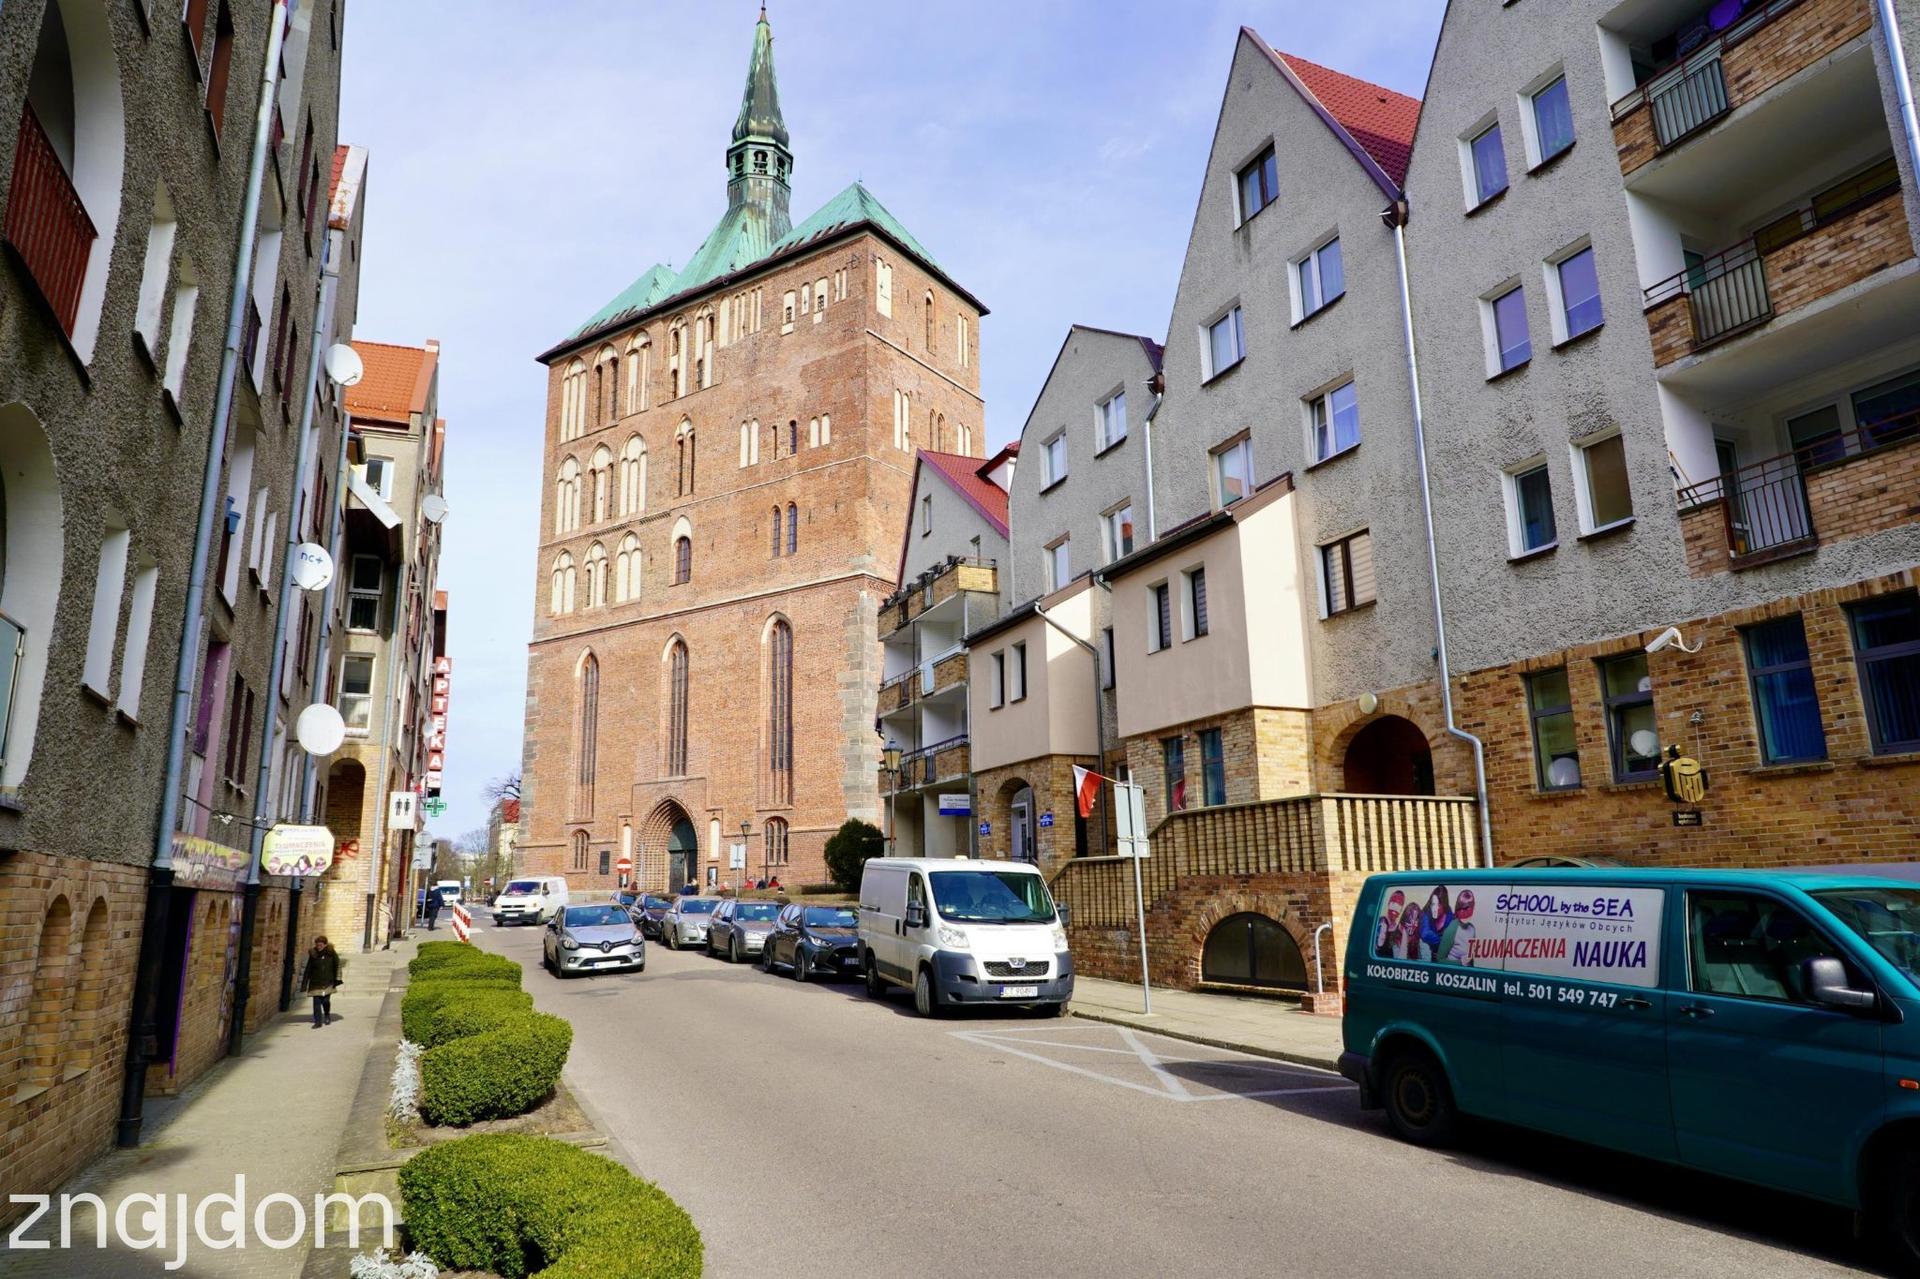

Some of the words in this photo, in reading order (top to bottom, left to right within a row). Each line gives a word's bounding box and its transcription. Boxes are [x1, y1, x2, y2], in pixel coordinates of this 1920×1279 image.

[300, 552, 323, 564] nc+
[429, 658, 450, 768] APTEKA
[1496, 894, 1558, 913] SCHOOL
[1560, 901, 1572, 914] by
[1573, 901, 1589, 913] the
[1592, 897, 1634, 918] SEA
[1540, 919, 1585, 930] Języków
[1589, 921, 1633, 934] Obcych
[1467, 937, 1566, 959] TŁUMACZENIA
[1572, 940, 1647, 968] NAUKA
[1366, 964, 1430, 985] KOŁOBRZEG
[1435, 972, 1497, 993] KOSZALIN
[1503, 981, 1524, 997] tel.
[1528, 984, 1552, 1000] 501
[1557, 987, 1585, 1004] 549
[1589, 990, 1618, 1009] 747
